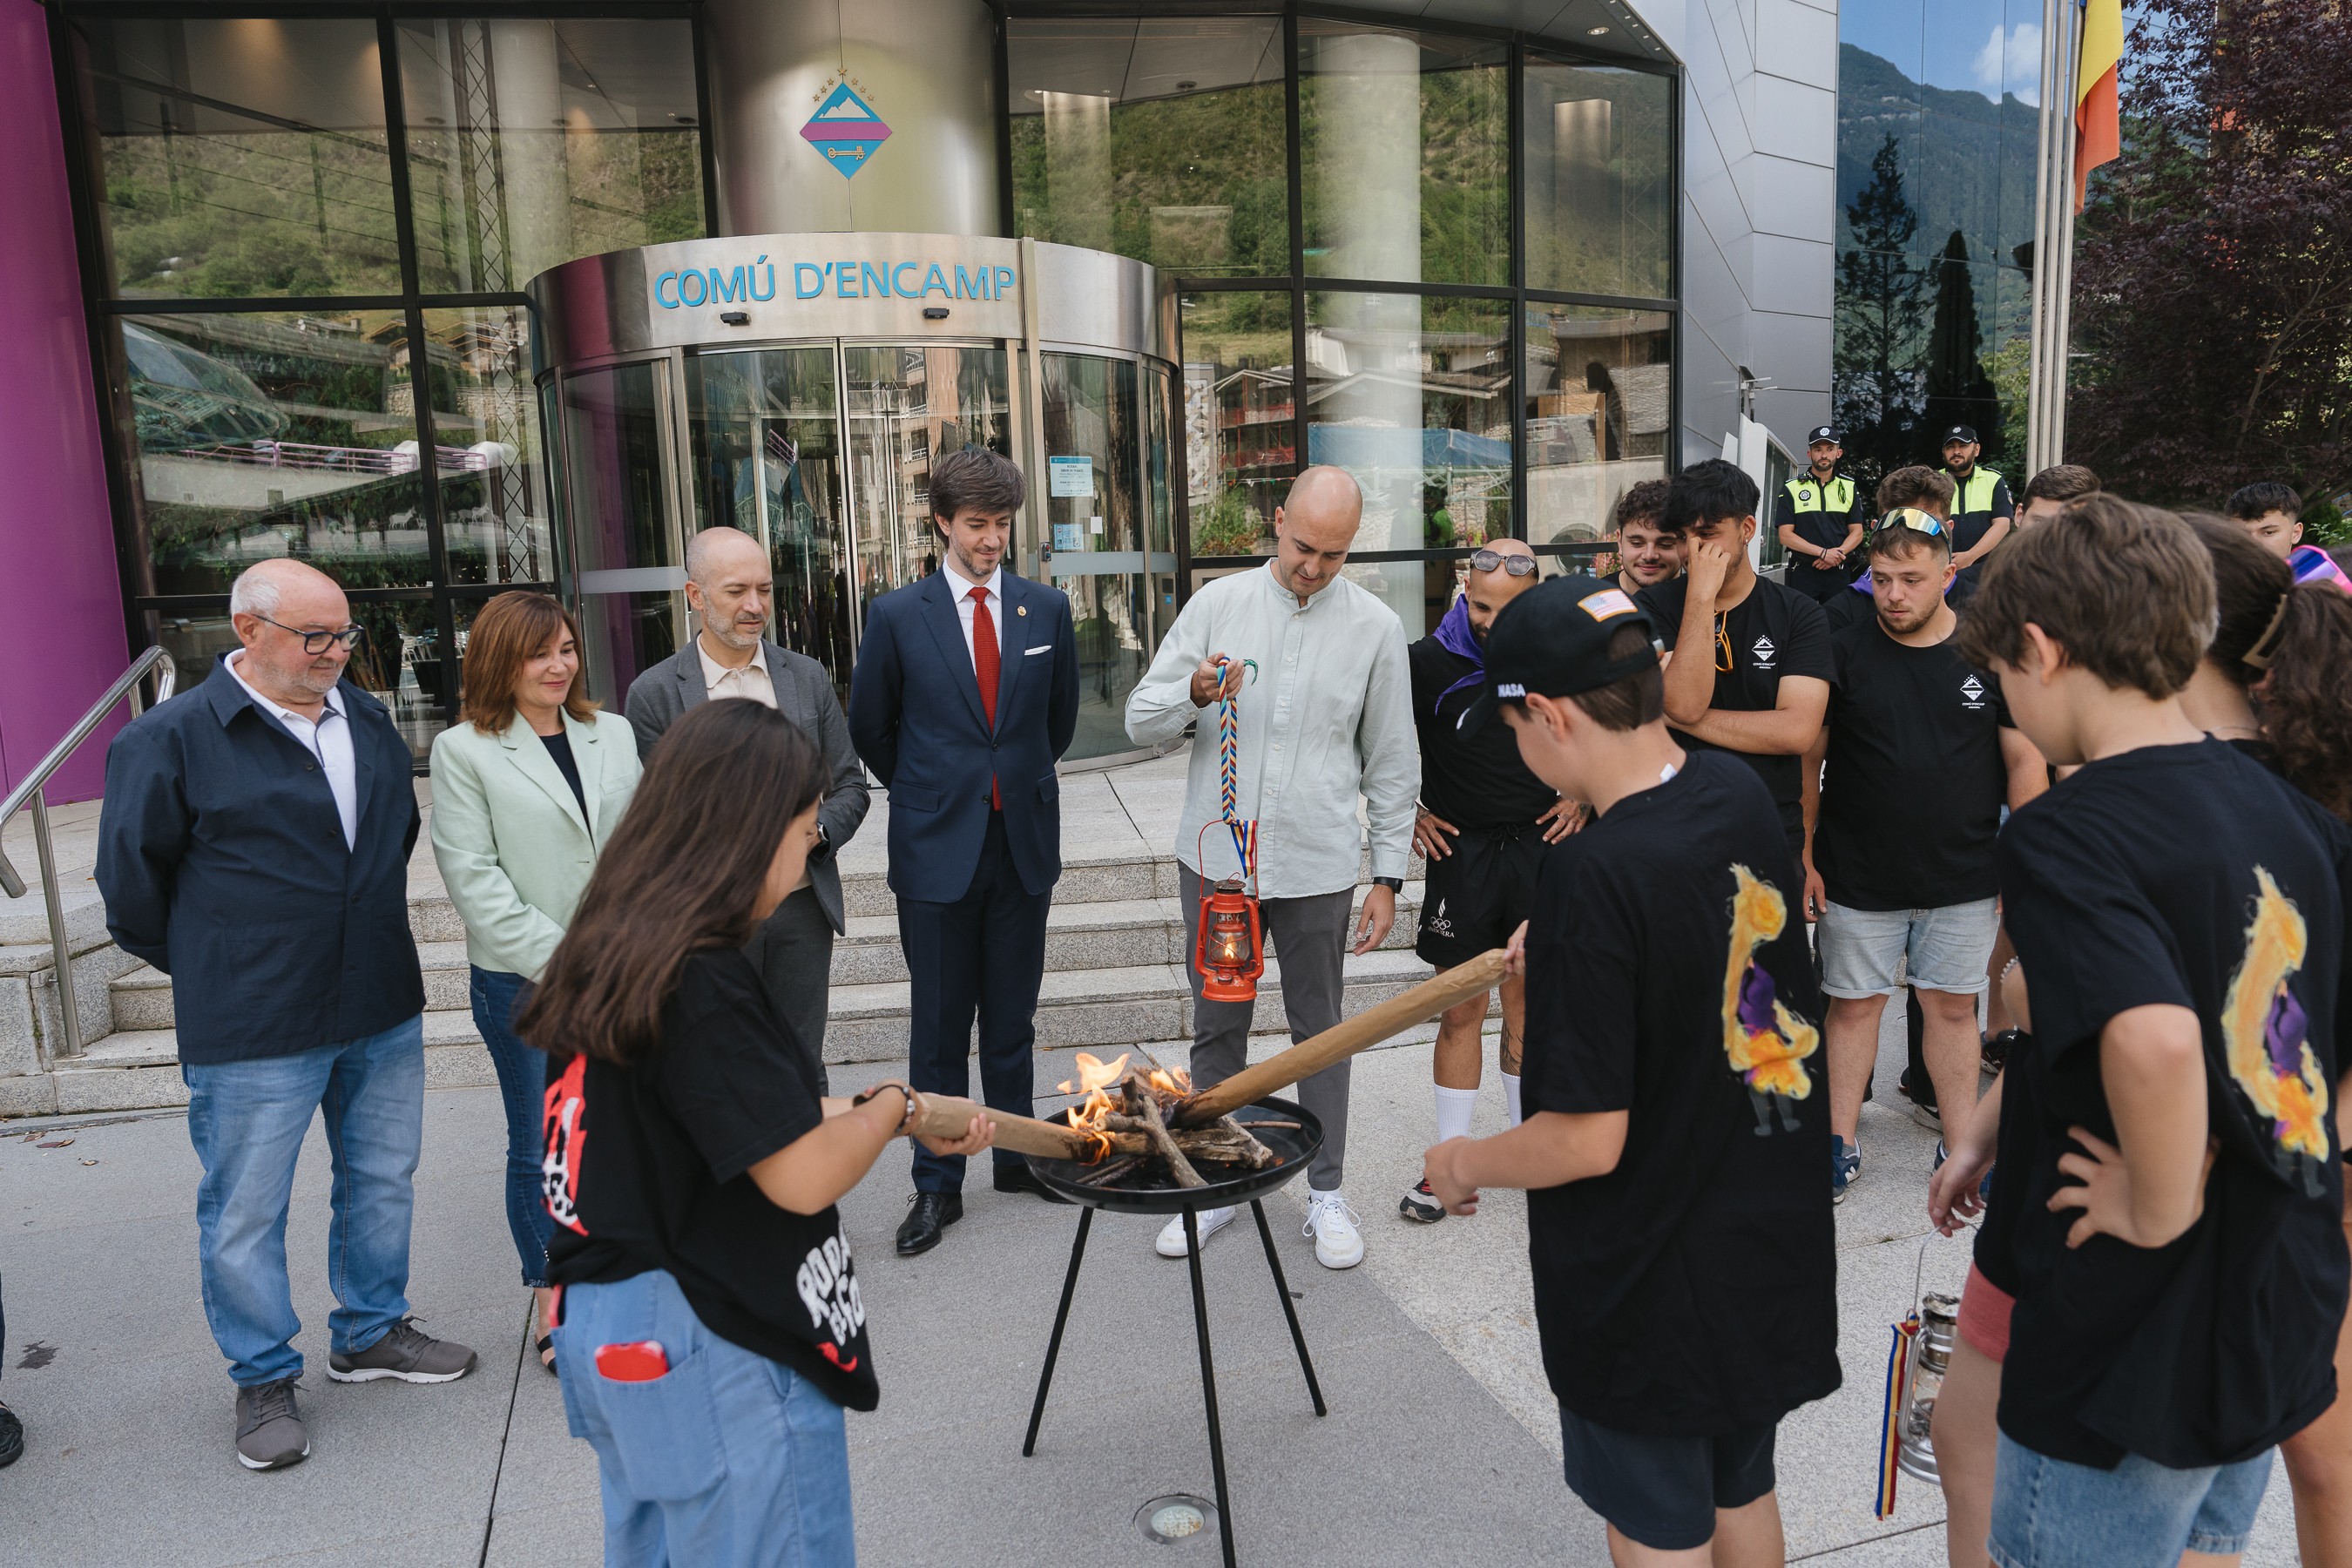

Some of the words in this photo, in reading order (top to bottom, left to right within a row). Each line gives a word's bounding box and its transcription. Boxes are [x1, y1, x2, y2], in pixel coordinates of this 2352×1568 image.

[654, 254, 776, 309] COMÚ
[794, 260, 1016, 301] D'ENCAMP
[1497, 683, 1526, 698] NASA
[1428, 926, 1455, 938] ANDORRA
